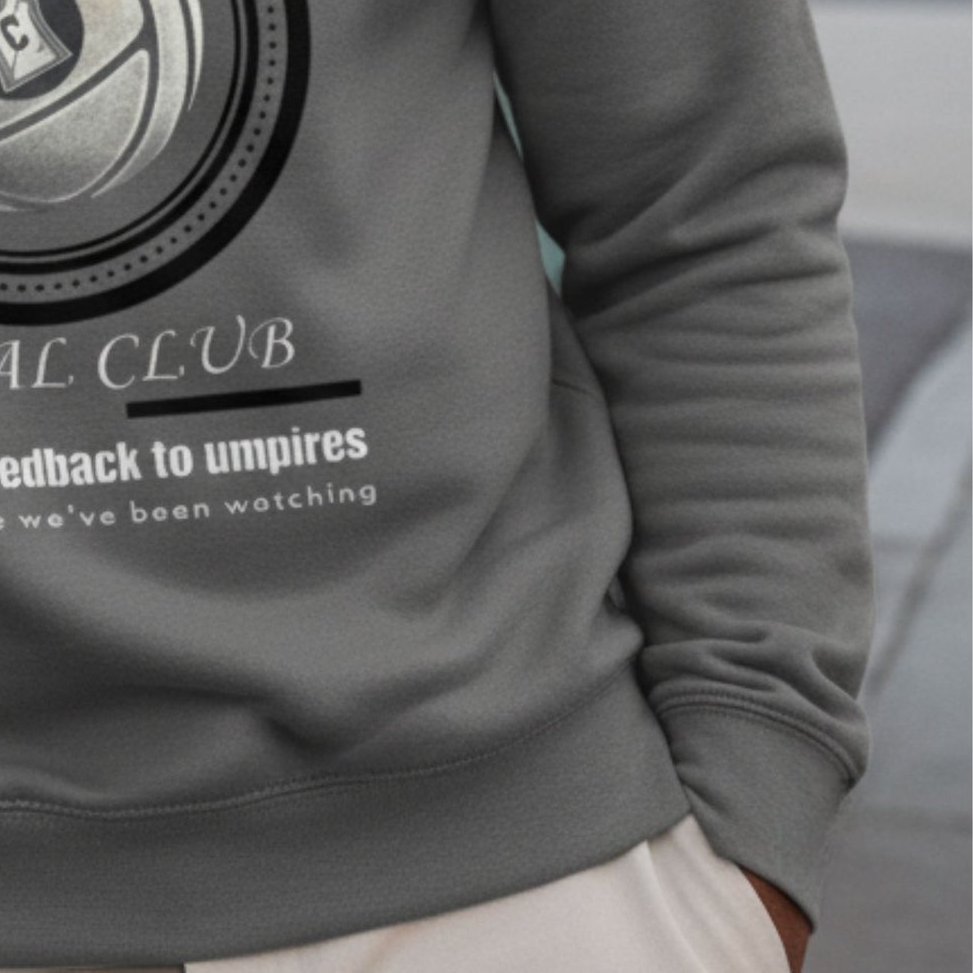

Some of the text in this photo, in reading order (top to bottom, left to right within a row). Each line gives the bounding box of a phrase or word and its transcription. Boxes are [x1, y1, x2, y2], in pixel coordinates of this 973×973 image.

[0, 14, 29, 51] C
[97, 314, 295, 389] CLUB
[151, 441, 193, 478] to
[204, 426, 368, 475] umpires
[19, 504, 116, 528] we've
[129, 500, 210, 524] been
